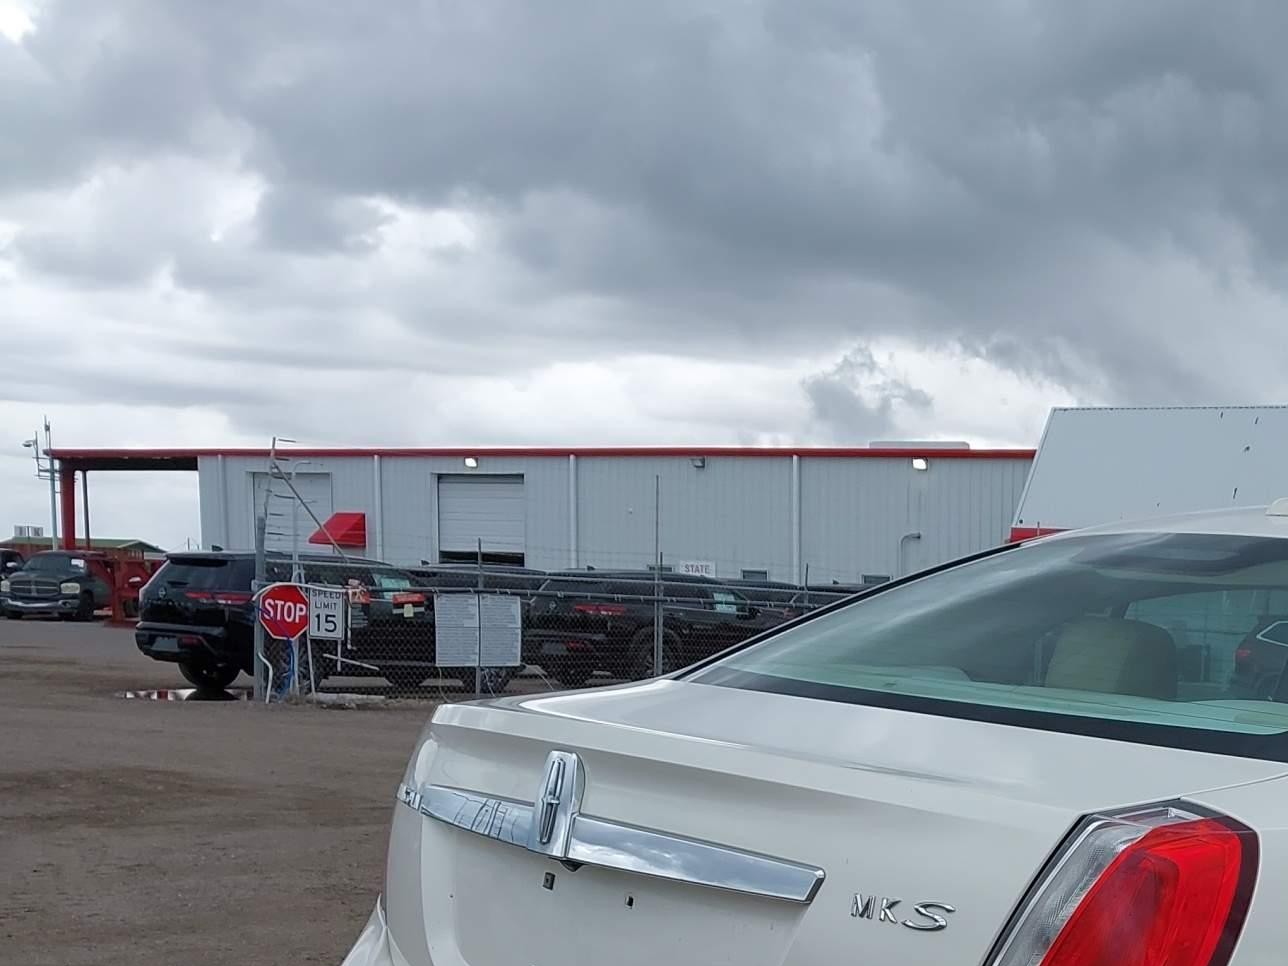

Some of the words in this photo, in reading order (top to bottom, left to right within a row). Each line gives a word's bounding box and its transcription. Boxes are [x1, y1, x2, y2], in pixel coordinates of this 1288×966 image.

[684, 564, 710, 574] STATE
[312, 589, 341, 599] SPEED
[263, 598, 306, 623] STOP
[314, 601, 337, 610] LIMIT
[315, 613, 337, 632] 15
[850, 892, 956, 932] MKS
